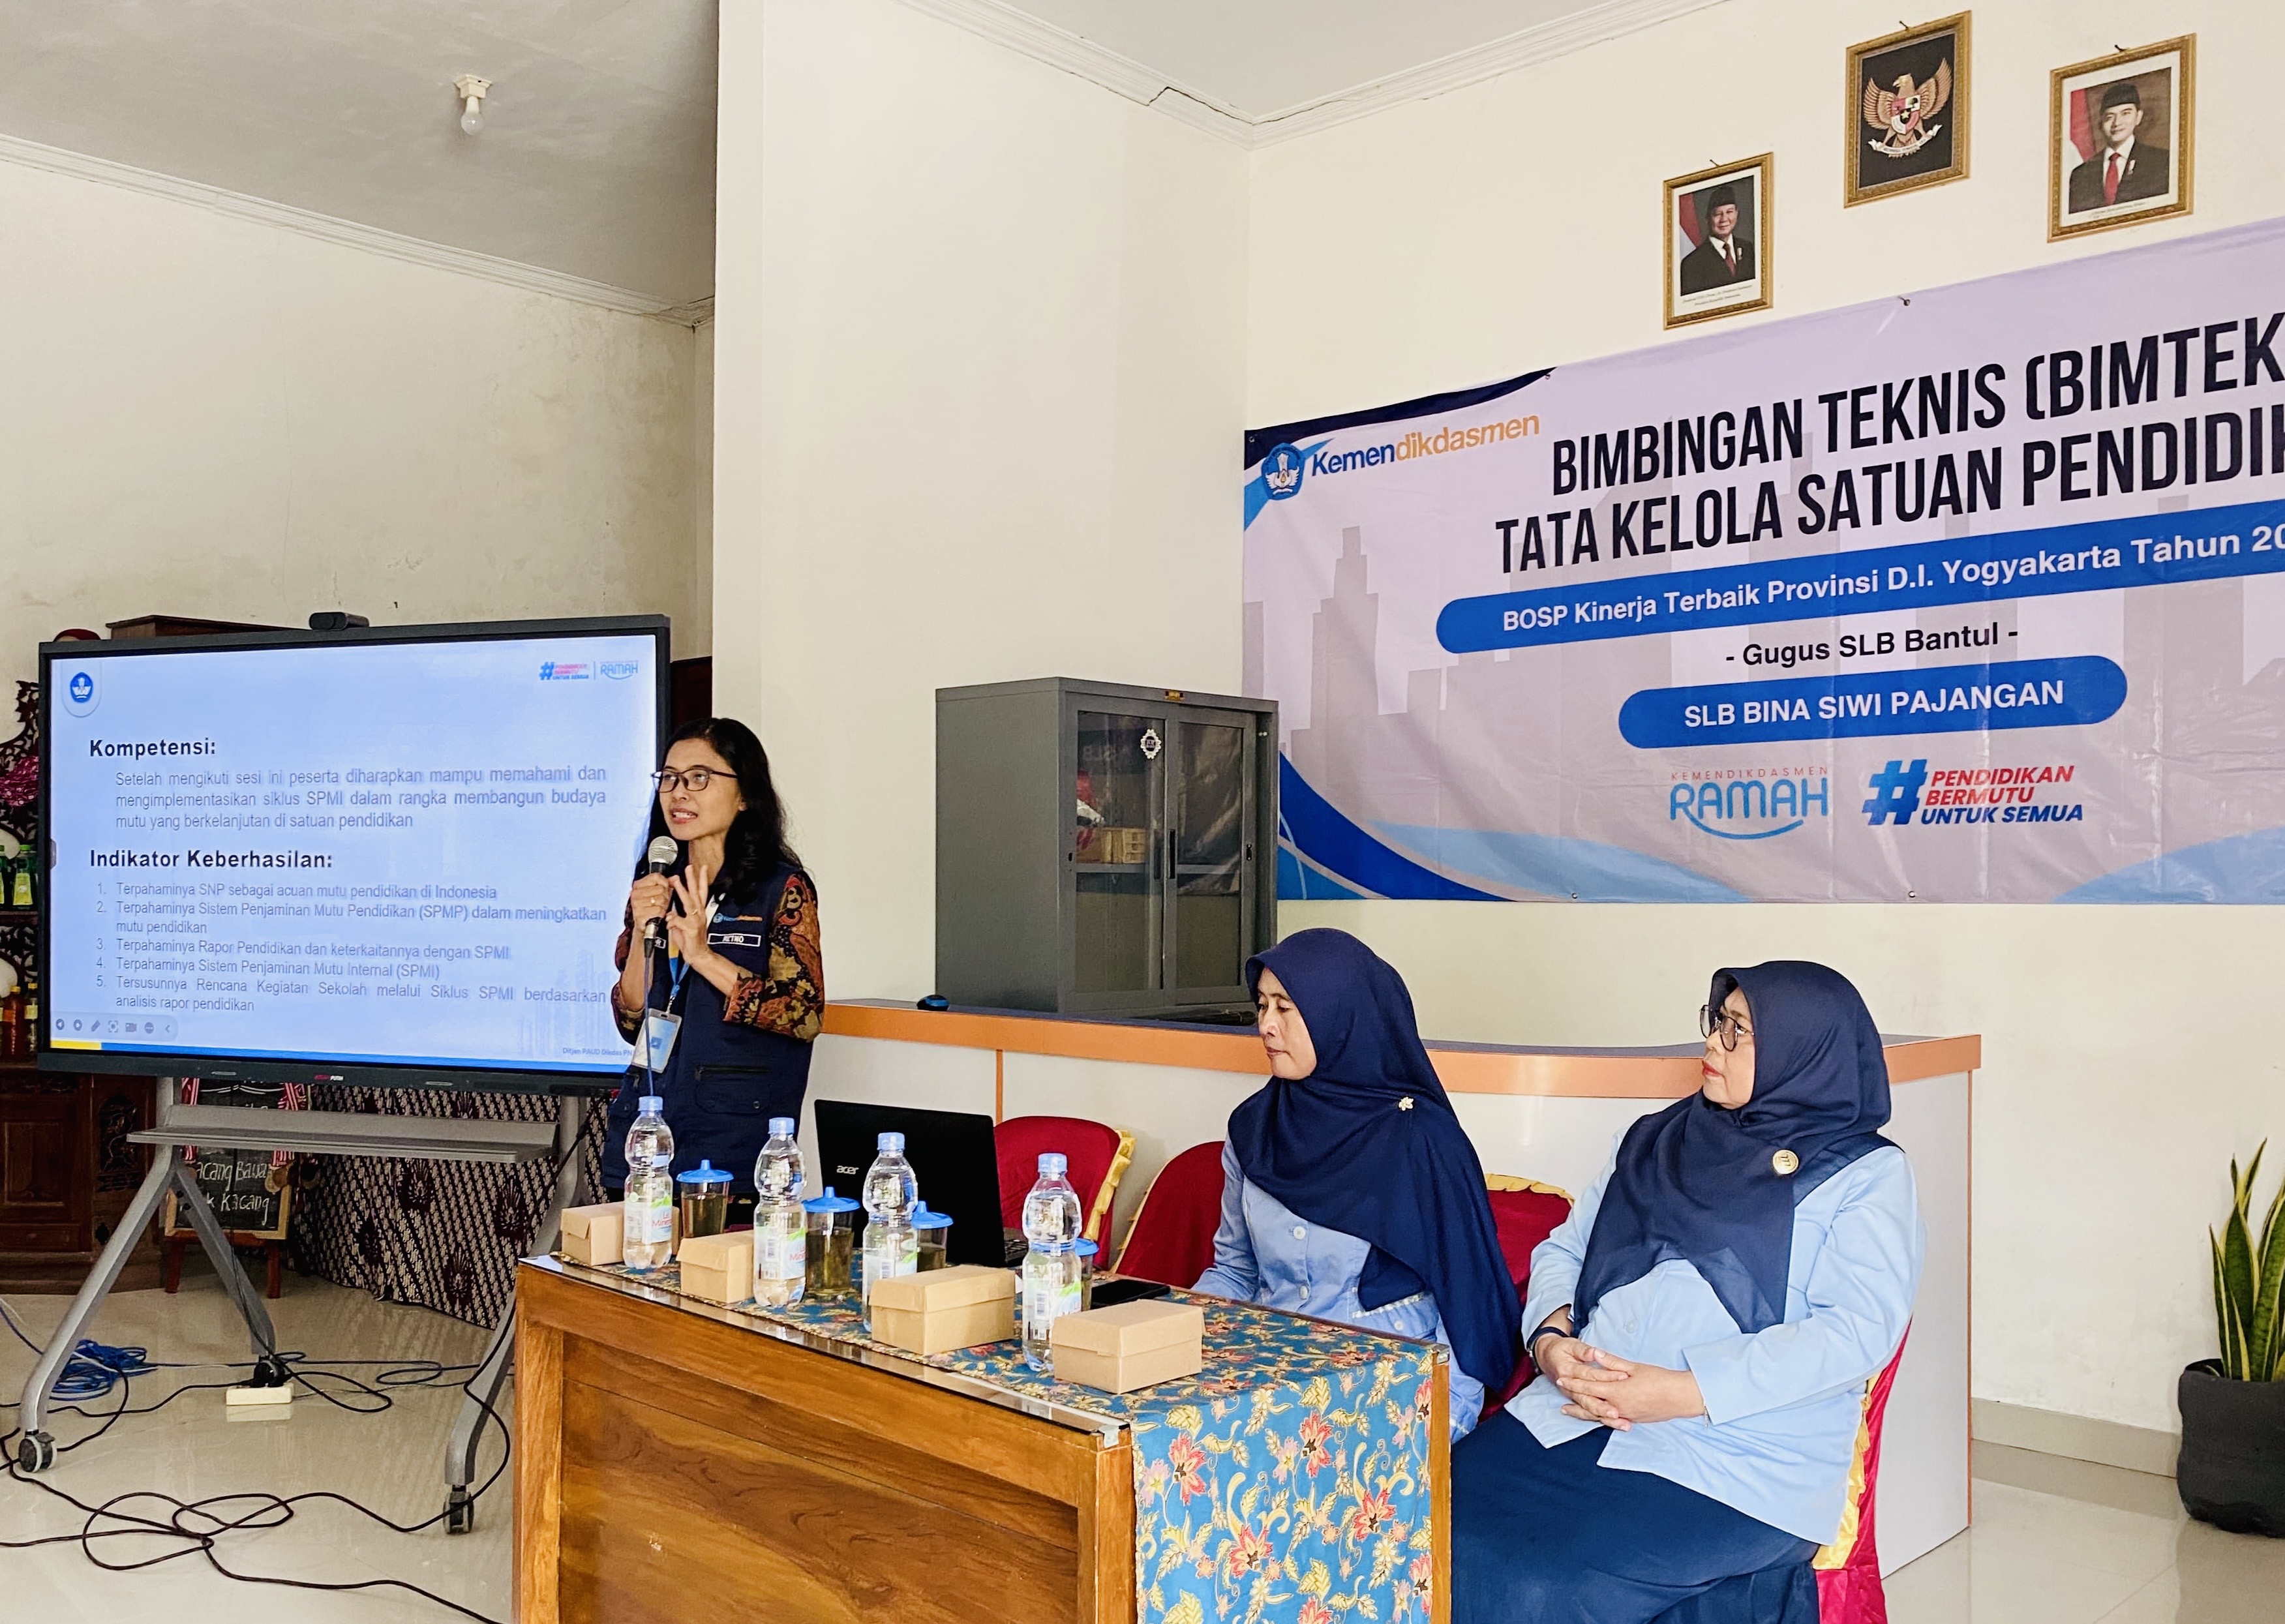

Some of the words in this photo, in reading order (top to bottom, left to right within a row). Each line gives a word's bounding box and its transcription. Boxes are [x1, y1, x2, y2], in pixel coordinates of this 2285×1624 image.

[1553, 398, 1802, 496] BIMBINGAN
[1819, 363, 2006, 453] TEKNIS
[2026, 312, 2285, 419] (BIMTEK
[1312, 414, 1540, 477] Kemendikdasmen
[1496, 507, 1599, 574] TATA
[1612, 480, 1782, 560] KELOLA
[1798, 446, 2002, 535] SATUAN
[1504, 606, 1567, 631] BOSP
[1575, 595, 1656, 622] Kinerja
[1665, 586, 1760, 613] Terbaik
[1768, 570, 1877, 603] Provinsi
[1888, 567, 1933, 591] D.I.
[1943, 545, 2121, 586] Yogyakarta
[2132, 533, 2240, 564] Tahun
[1743, 642, 1830, 669] Gugus
[1839, 632, 1895, 657] SLB
[1906, 622, 1998, 650] Bantul
[600, 664, 638, 674] RAMAH
[1685, 703, 1735, 727] SLB
[1744, 698, 1810, 724] BINA
[1819, 693, 1881, 719] SIWI
[1892, 680, 2063, 715] PAJANGAN
[90, 738, 215, 760] Kompetensi:
[116, 772, 162, 787] Setelah
[169, 770, 228, 788] mengikuti
[236, 770, 260, 785] sesi
[269, 770, 282, 783] ini
[290, 770, 339, 788] peserta
[346, 768, 422, 787] diharapkan
[431, 770, 482, 787] mampu
[490, 766, 570, 782] memahami
[579, 766, 606, 781] dan
[1671, 766, 1828, 781] KEMENDIKDASMEN
[1931, 766, 2074, 787] PENDIDIKAN
[117, 792, 256, 810] mengimplementasikan
[264, 791, 299, 805] siklus
[307, 791, 344, 805] SPMI
[350, 790, 391, 805] dalam
[399, 790, 446, 808] rangka
[455, 789, 544, 808] membangun
[552, 789, 606, 807] budaya
[1671, 777, 1828, 820] RAMAH
[1926, 787, 2035, 805] BERMUTU
[116, 815, 145, 828] mutu
[150, 817, 180, 831] yang
[185, 813, 270, 831] berkelanjutan
[275, 813, 286, 828] di
[290, 814, 335, 828] satuan
[339, 813, 413, 831] pendidikan
[1921, 807, 1995, 825] UNTUK
[2003, 804, 2083, 822] SEMUA
[90, 850, 179, 867] Indikator
[187, 850, 333, 868] Keberhasilan:
[117, 882, 196, 899] Terpahaminya
[199, 884, 224, 896] SNP
[229, 883, 274, 899] sebagai
[277, 886, 313, 897] acuan
[318, 886, 346, 897] mutu
[351, 886, 416, 901] pendidikan
[421, 886, 431, 899] di
[435, 886, 496, 899] Indonesia
[117, 901, 196, 918] Terpahaminya
[199, 902, 237, 915] Sistem
[241, 903, 310, 920] Penjaminan
[314, 904, 343, 917] Mutu
[348, 903, 415, 918] Pendidikan
[419, 904, 468, 922] (SPMP)
[472, 905, 511, 920] dalam
[515, 907, 607, 924] meningkatkan
[117, 921, 143, 932] mutu
[147, 920, 207, 936] pendidikan
[117, 939, 195, 955] Terpahaminya
[199, 940, 234, 956] Rapor
[237, 940, 301, 955] Pendidikan
[305, 942, 327, 955] dan
[331, 943, 419, 961] keterkaitannya
[423, 944, 471, 962] dengan
[474, 945, 510, 959] SPMI
[117, 957, 195, 974] Terpahaminya
[199, 959, 237, 973] Sistem
[241, 960, 310, 976] Penjaminan
[314, 961, 343, 976] Mutu
[348, 963, 393, 977] Internal
[397, 965, 440, 979] (SPMI)
[117, 976, 187, 992] Tersusunnya
[197, 978, 247, 993] Rencana
[257, 980, 309, 997] Kegiatan
[318, 982, 367, 996] Sekolah
[377, 984, 420, 998] melalui
[431, 985, 468, 999] Siklus
[479, 986, 514, 1000] SPMI
[524, 988, 606, 1003] berdasarkan
[116, 996, 157, 1009] analisis
[160, 998, 189, 1012] rapor
[193, 997, 254, 1012] pendidikan
[836, 1164, 859, 1174] acer
[220, 1192, 269, 1226] Kacang
